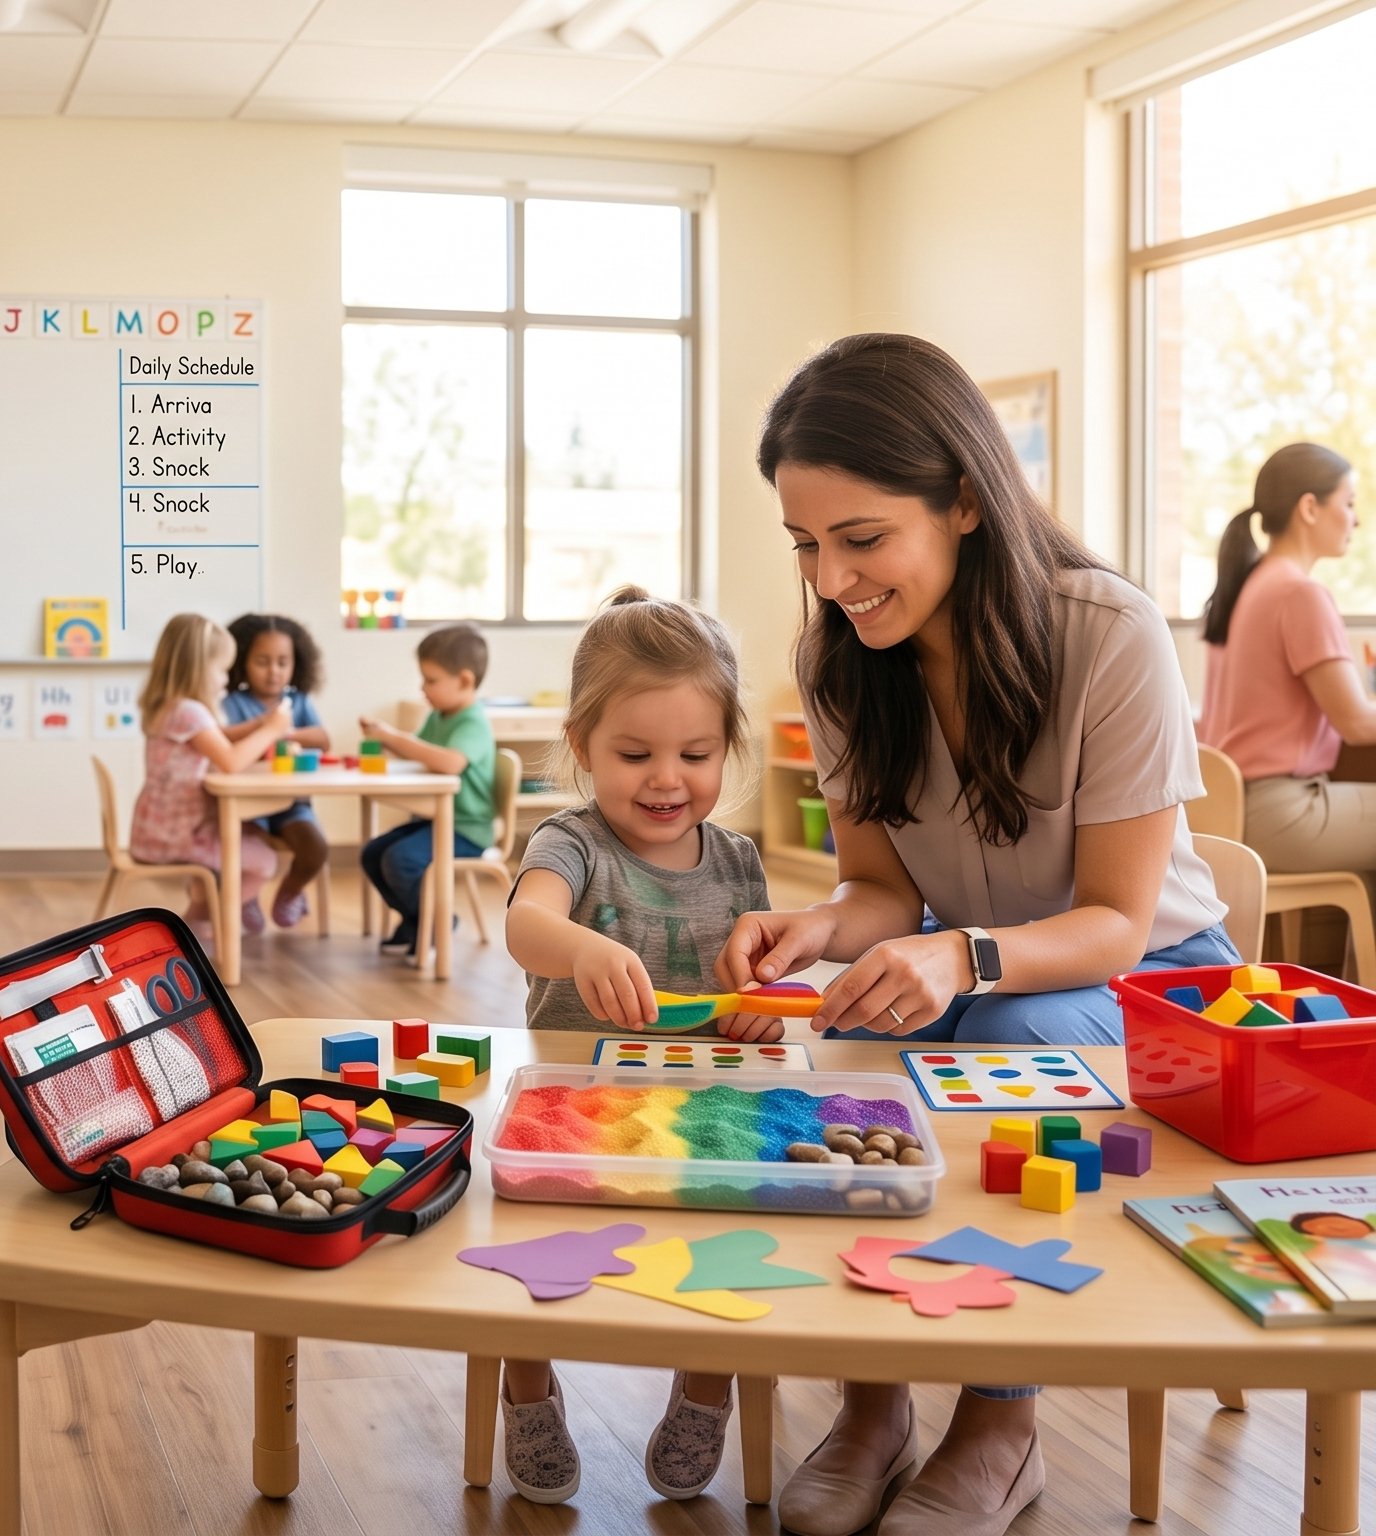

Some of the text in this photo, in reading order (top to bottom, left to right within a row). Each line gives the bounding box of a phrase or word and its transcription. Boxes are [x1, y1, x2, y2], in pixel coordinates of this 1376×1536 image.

[3, 309, 23, 333] J
[42, 309, 61, 333] K
[82, 309, 98, 334] L
[116, 310, 143, 334] M
[157, 310, 180, 336] O
[197, 311, 215, 336] P
[233, 312, 254, 336] Z
[130, 355, 255, 380] Daily Schedule
[151, 393, 211, 414] Arriva
[128, 425, 226, 452] 2. Activity
[128, 456, 210, 477] 3. Snock
[129, 492, 210, 513] 4. Snock
[131, 553, 147, 574] 5.
